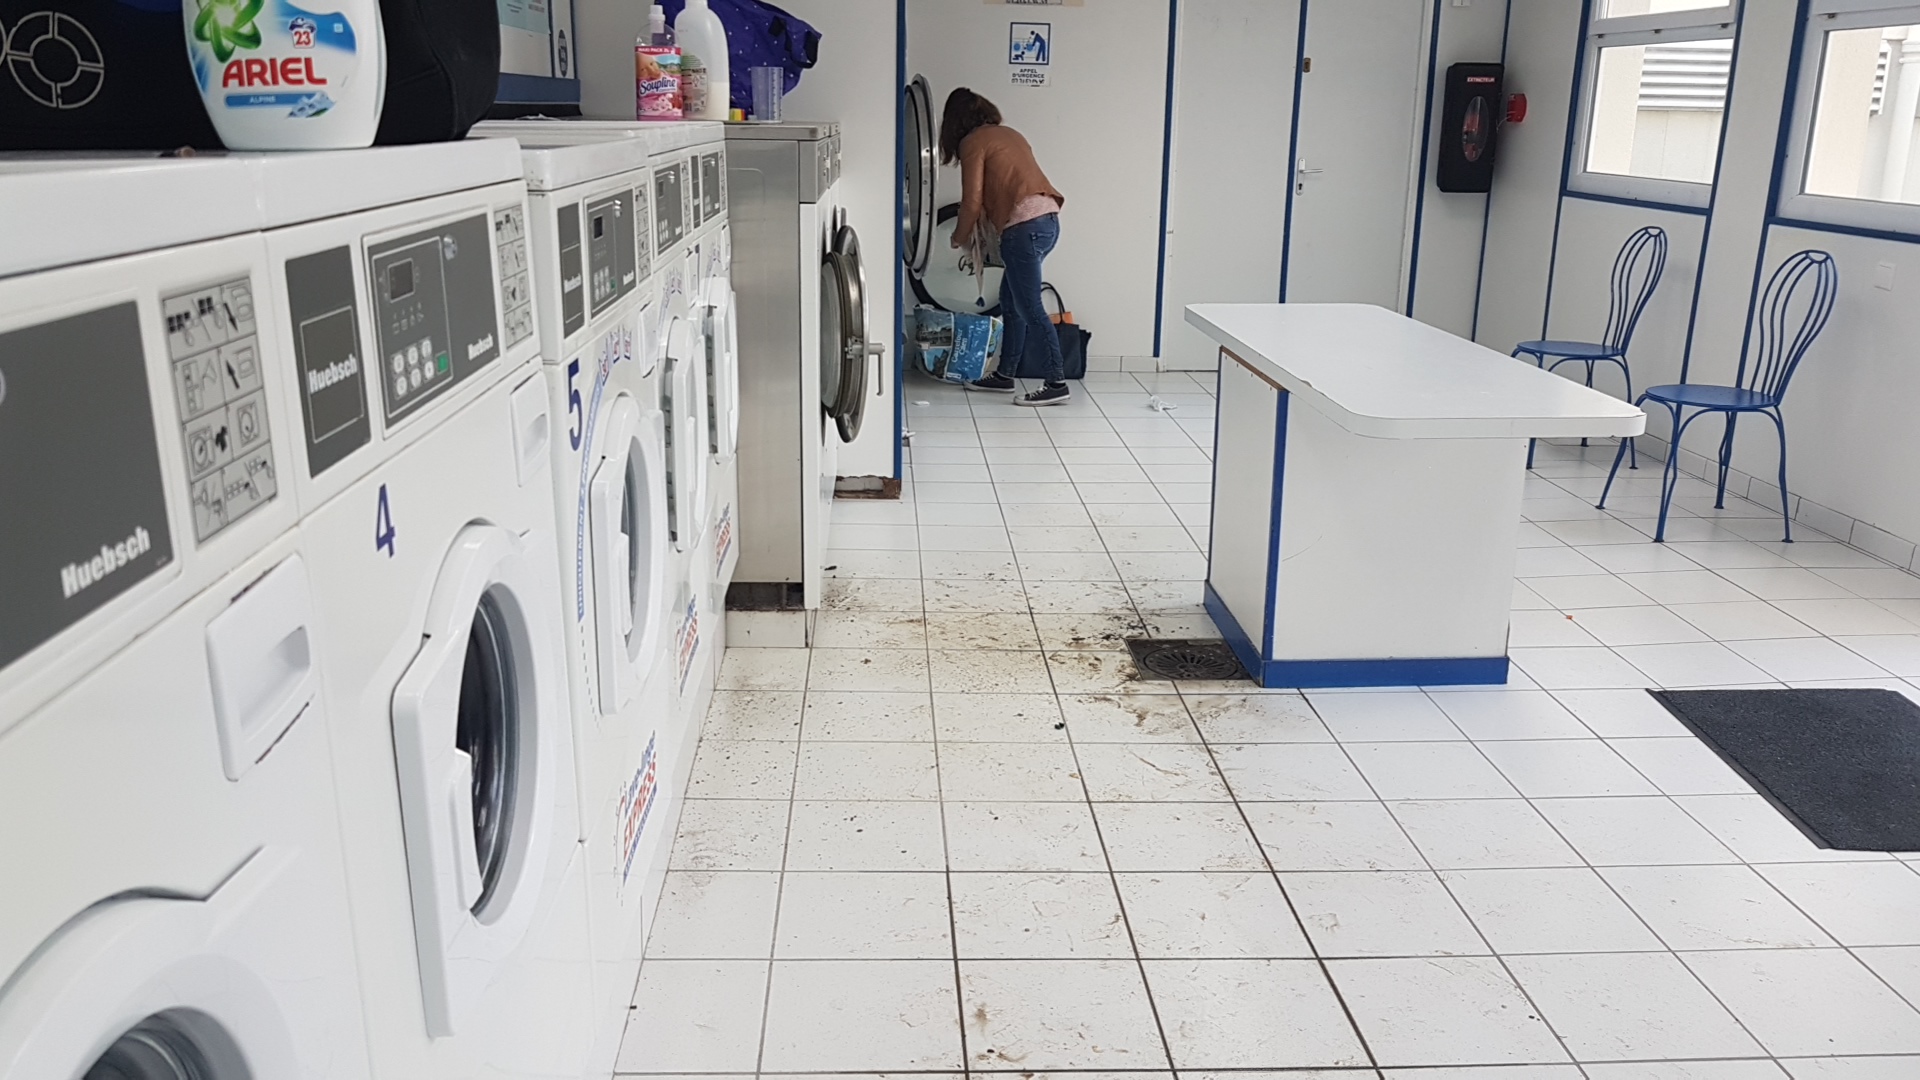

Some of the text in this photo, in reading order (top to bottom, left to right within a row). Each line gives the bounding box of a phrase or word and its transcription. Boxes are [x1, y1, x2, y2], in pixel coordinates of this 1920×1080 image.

[293, 30, 312, 46] 23
[222, 57, 328, 88] ARIEL
[639, 76, 676, 95] Soupline
[249, 95, 276, 104] ALPINE
[951, 328, 963, 363] Carrefour
[959, 337, 968, 355] Caen
[308, 353, 359, 395] Huebsch
[567, 357, 583, 452] 5
[376, 482, 397, 559] 4
[60, 525, 152, 600] Huebsch
[623, 750, 657, 862] EXPRESS
